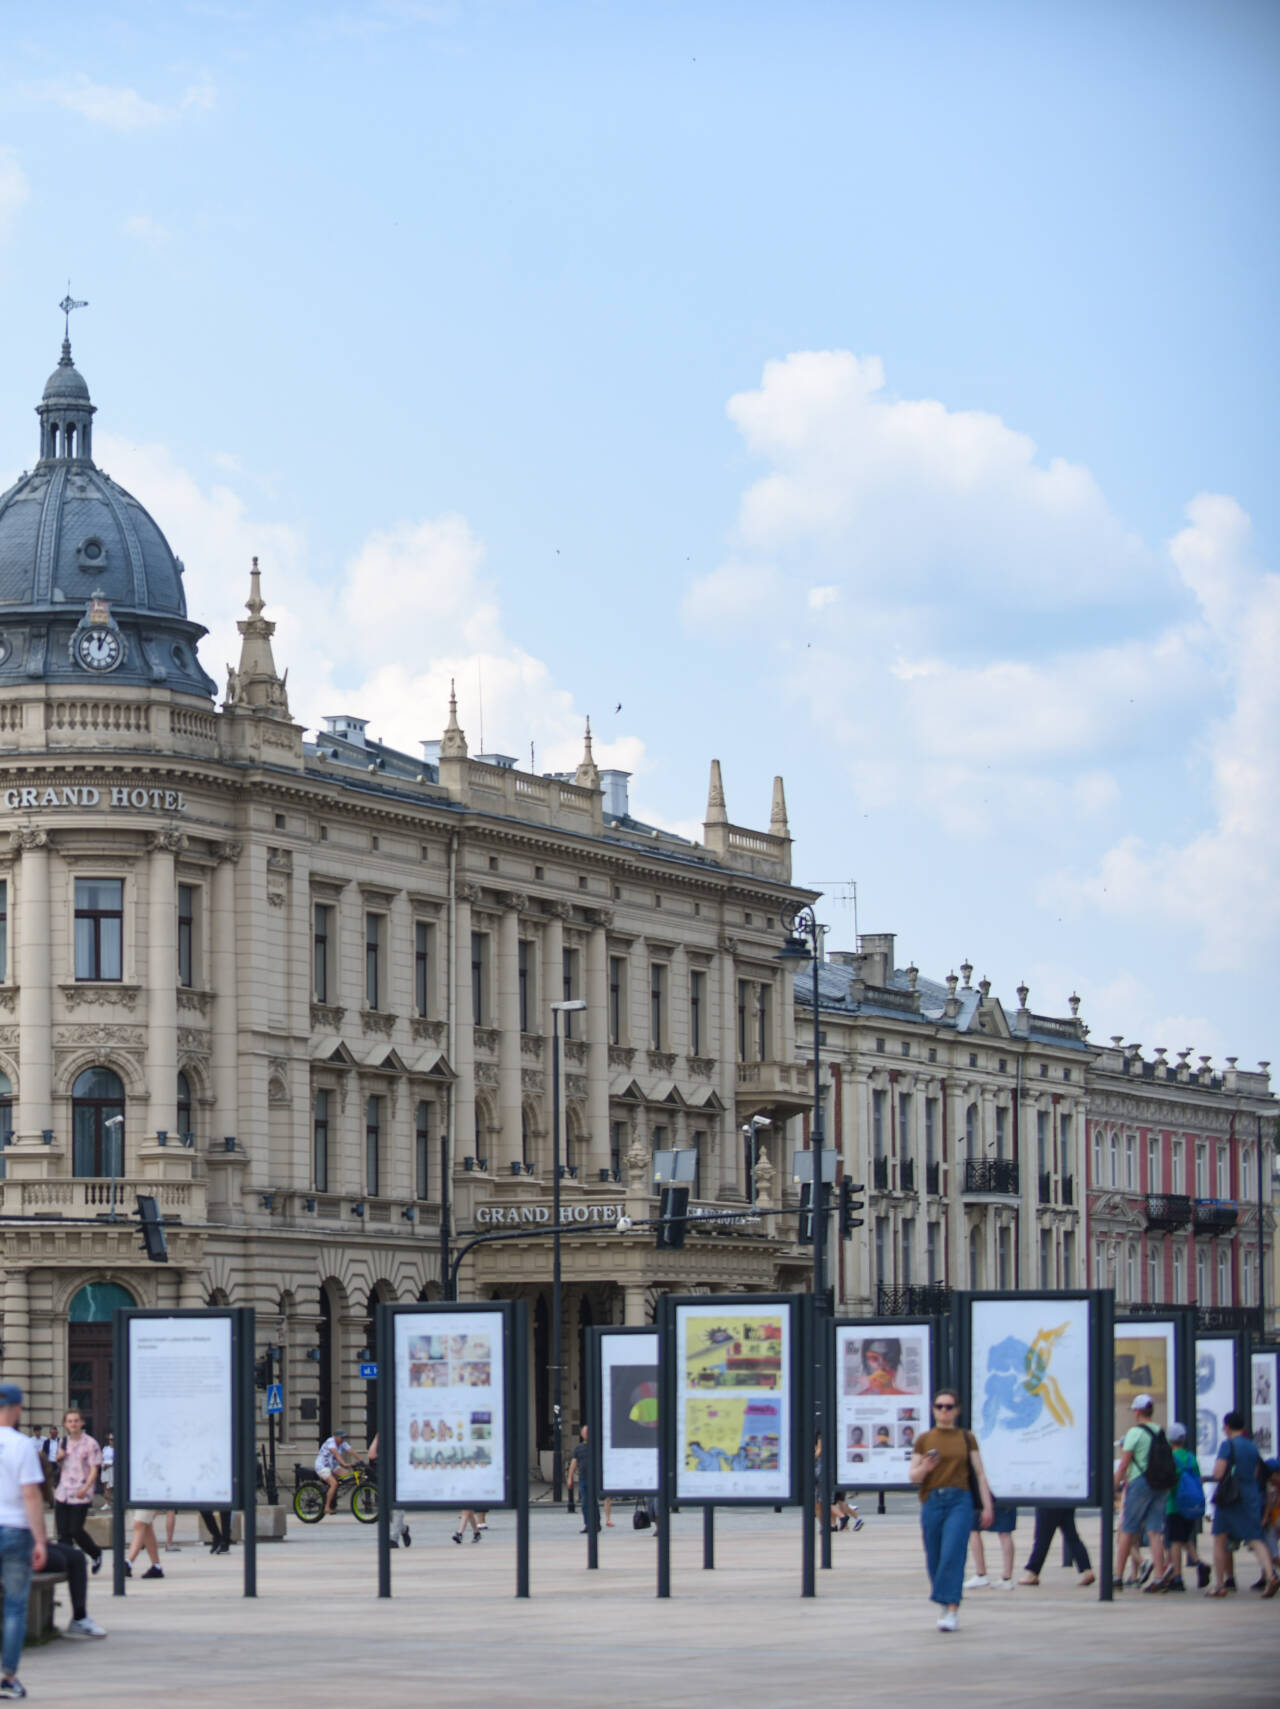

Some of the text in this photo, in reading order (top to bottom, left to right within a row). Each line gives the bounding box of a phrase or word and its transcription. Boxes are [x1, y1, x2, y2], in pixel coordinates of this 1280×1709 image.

[4, 786, 188, 811] GRAND HOTEL
[476, 1205, 627, 1223] GRAND HOTEL
